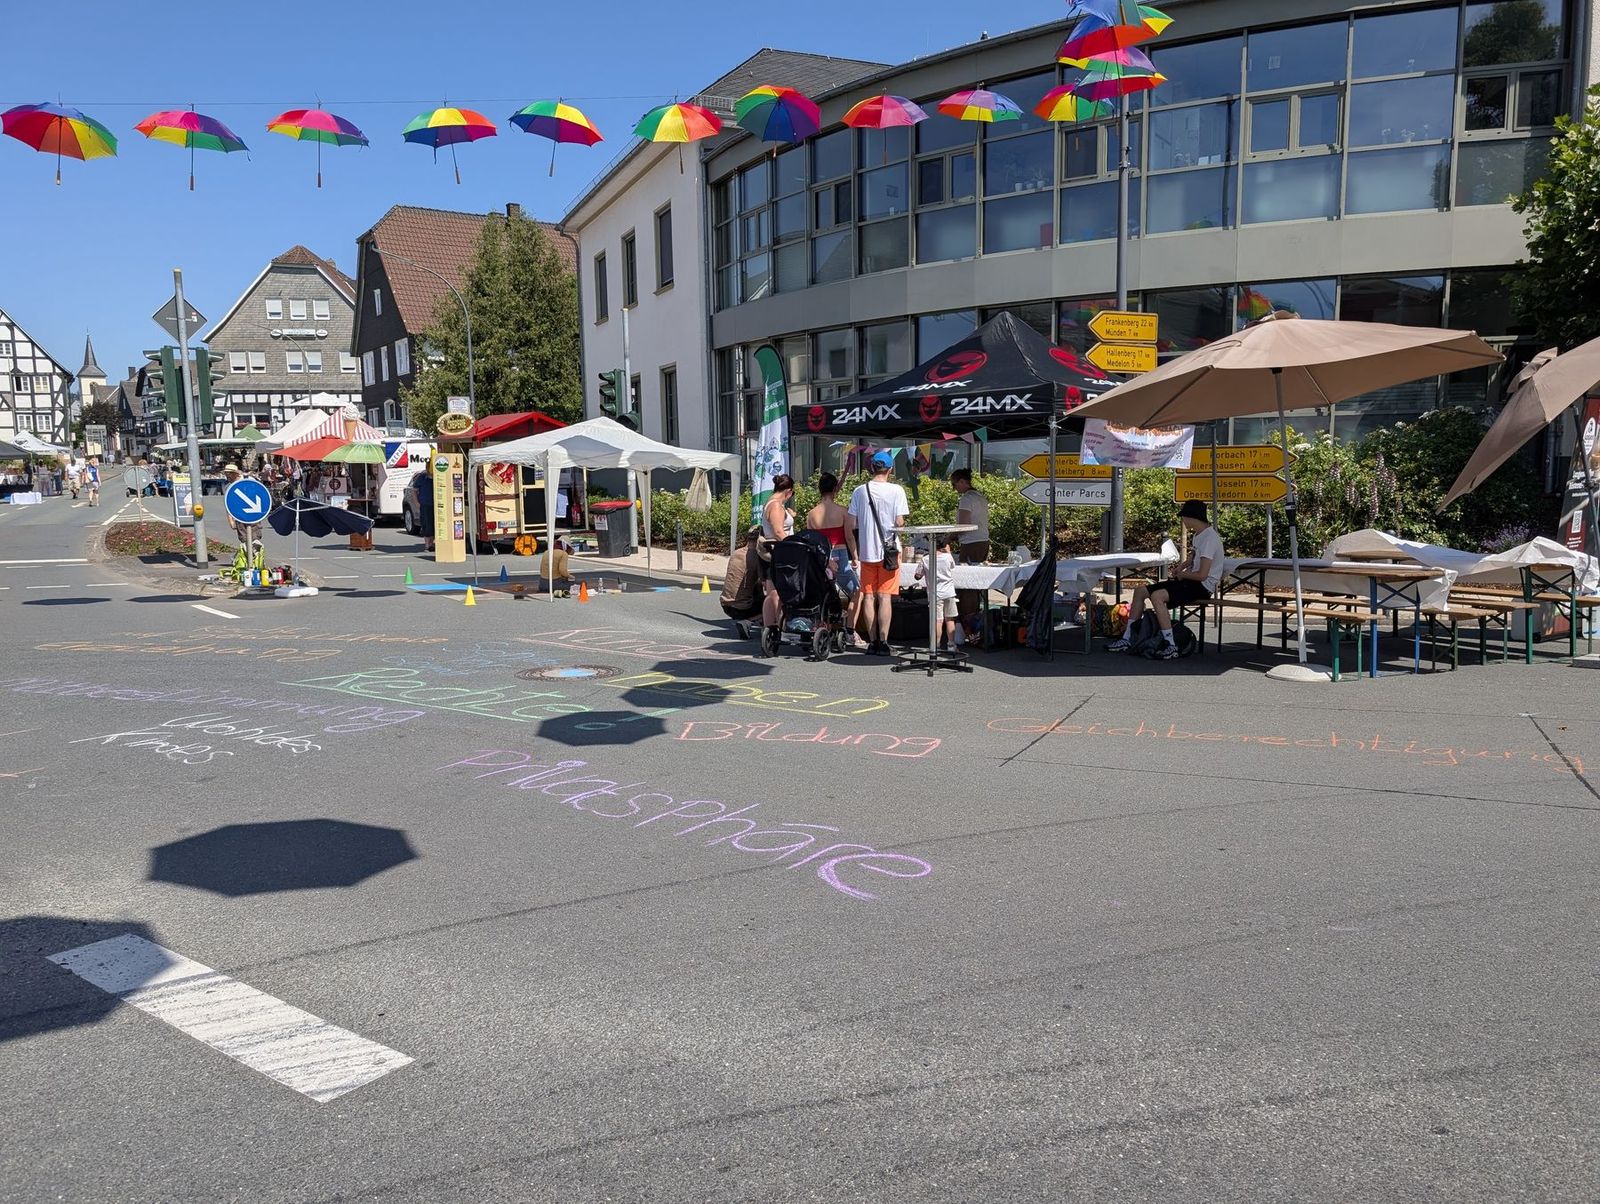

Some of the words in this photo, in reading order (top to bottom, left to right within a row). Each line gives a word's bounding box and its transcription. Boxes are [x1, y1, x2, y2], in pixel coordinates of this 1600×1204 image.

[1105, 317, 1139, 328] Frankenberg
[1141, 319, 1147, 327] 22
[1106, 348, 1136, 359] Hallenberg
[1138, 350, 1143, 358] 17
[1106, 359, 1130, 367] Medelon
[892, 379, 973, 394] 24MX
[950, 393, 1034, 415] 24MX
[832, 403, 902, 425] 24MX
[1249, 450, 1258, 458] 17
[1251, 461, 1257, 469] 4
[1091, 467, 1097, 475] 8
[1216, 480, 1247, 488] Usseln
[1044, 489, 1075, 498] Cnter
[1079, 489, 1106, 498] Parcs
[1253, 490, 1259, 498] 6
[672, 719, 942, 757] Bildung
